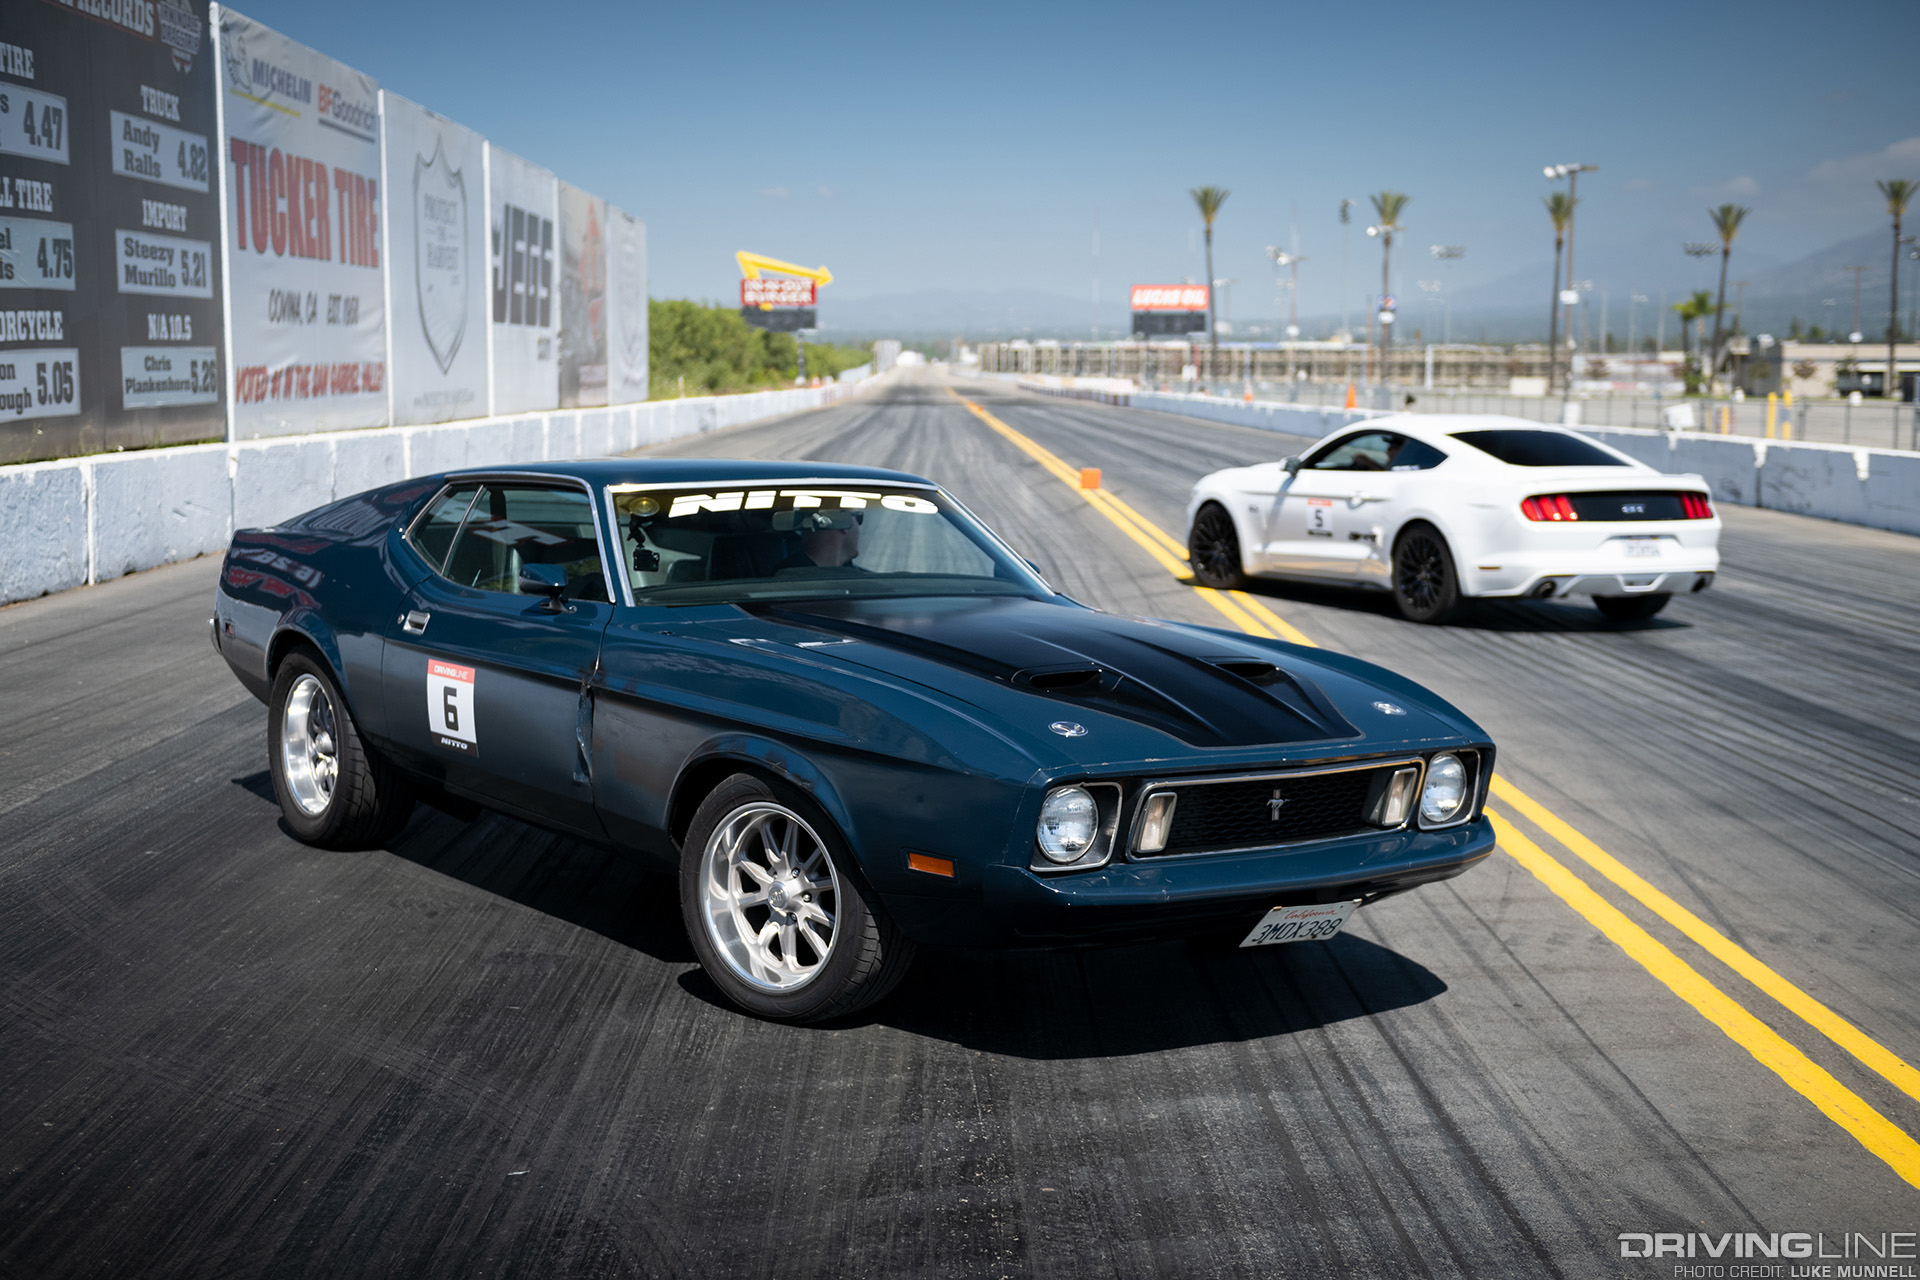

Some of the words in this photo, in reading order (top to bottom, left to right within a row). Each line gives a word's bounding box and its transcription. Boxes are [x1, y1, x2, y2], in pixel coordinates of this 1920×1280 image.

[252, 58, 312, 104] MICHELIN
[141, 84, 181, 122] TRUCK
[318, 83, 377, 132] BFGoodrich
[23, 100, 62, 151] 4.47
[123, 119, 160, 154] Andy
[123, 149, 162, 178] Ralls
[177, 140, 208, 182] 4.82
[15, 178, 53, 213] TIRE
[230, 136, 331, 262] TUCKER
[334, 167, 379, 269] TIRE
[142, 199, 188, 233] IMPORT
[37, 237, 73, 279] 4.75
[124, 237, 175, 266] Steezy
[181, 249, 207, 288] 5.21
[124, 264, 177, 288] Murillo
[305, 291, 318, 325] CA
[1131, 288, 1181, 306] LUCAS
[1181, 288, 1206, 306] OIL
[169, 315, 192, 341] 10.5
[144, 355, 172, 372] Chris
[190, 359, 217, 394] 5.26
[36, 361, 74, 406] 5.05
[125, 377, 191, 394] Plankenhorn
[236, 365, 268, 404] VOTED
[295, 364, 311, 400] THE
[668, 490, 939, 518] NITTO
[1314, 509, 1323, 528] 5
[443, 686, 460, 732] 6
[441, 737, 468, 750] NITTO
[1285, 909, 1338, 920] California
